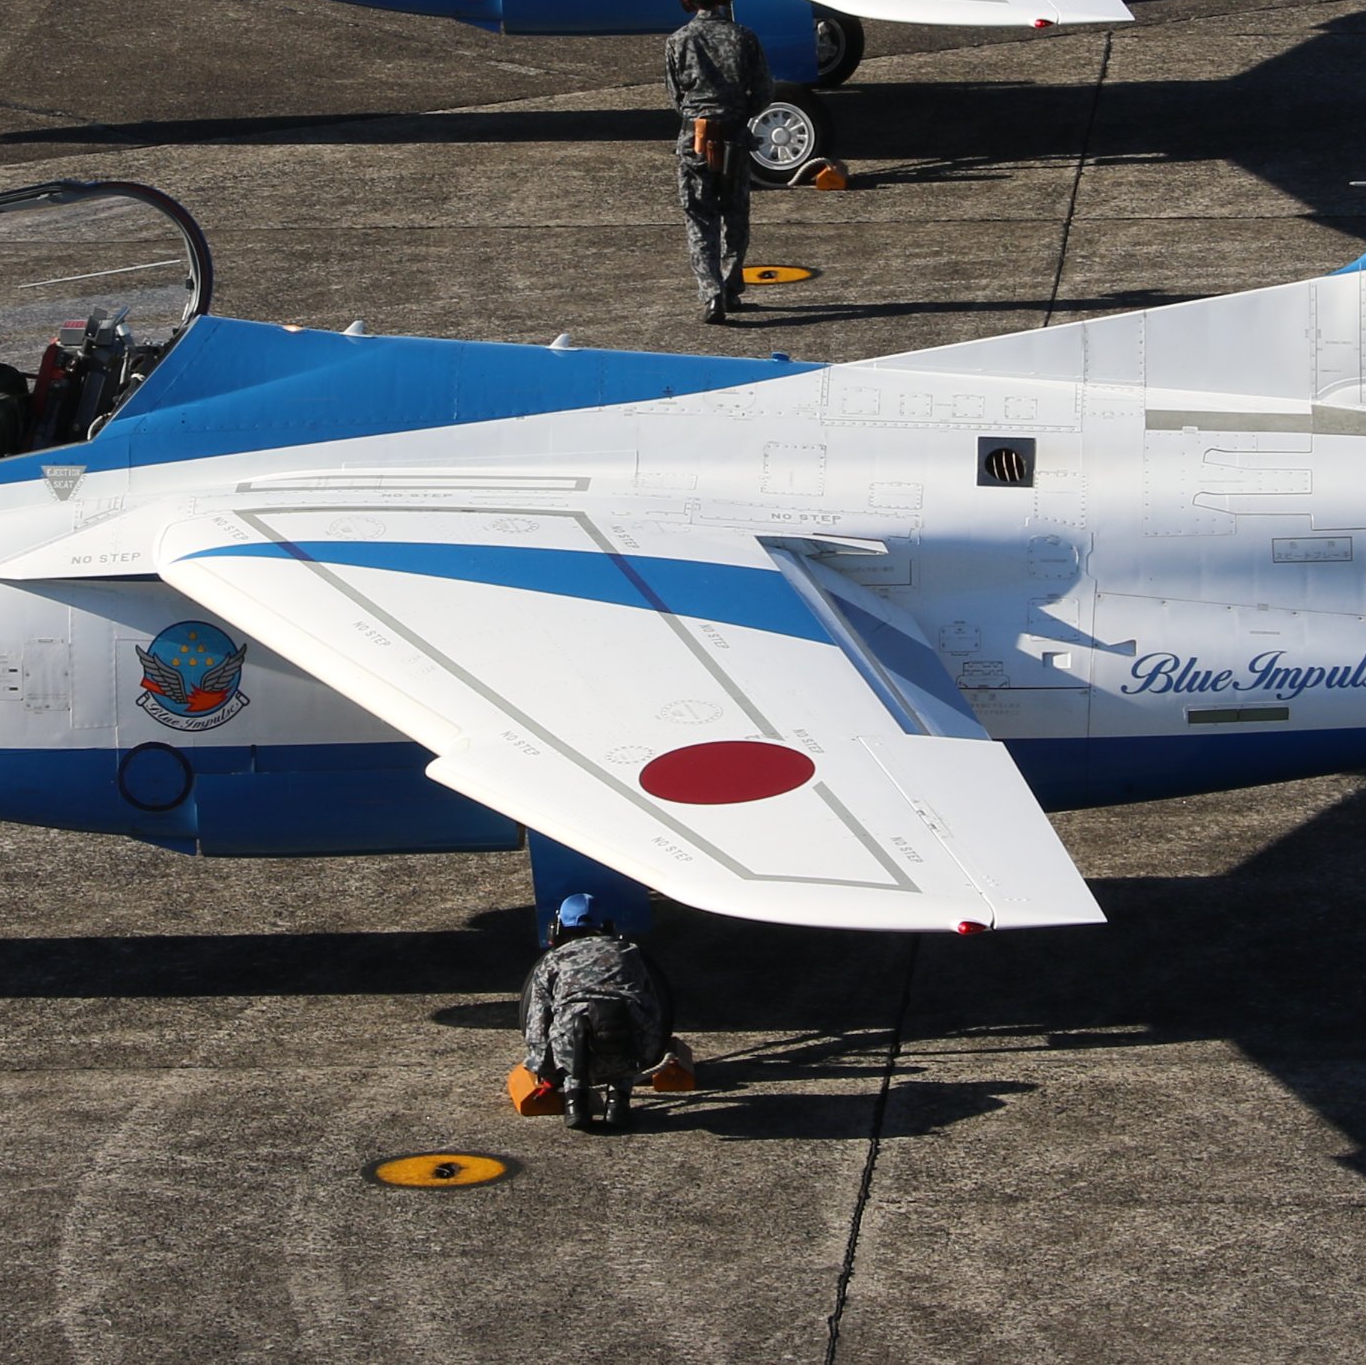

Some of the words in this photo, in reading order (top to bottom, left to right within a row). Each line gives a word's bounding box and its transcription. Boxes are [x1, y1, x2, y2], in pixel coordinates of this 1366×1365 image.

[46, 468, 81, 477] EJECTION
[53, 480, 75, 489] SEAT
[771, 512, 796, 520] NO
[801, 514, 842, 522] STEP
[71, 554, 92, 565] NO
[99, 552, 142, 563] STEP
[363, 627, 391, 647] STEP
[1121, 651, 1234, 694] Blue
[145, 702, 180, 727] Blue
[180, 702, 239, 729] Impulse
